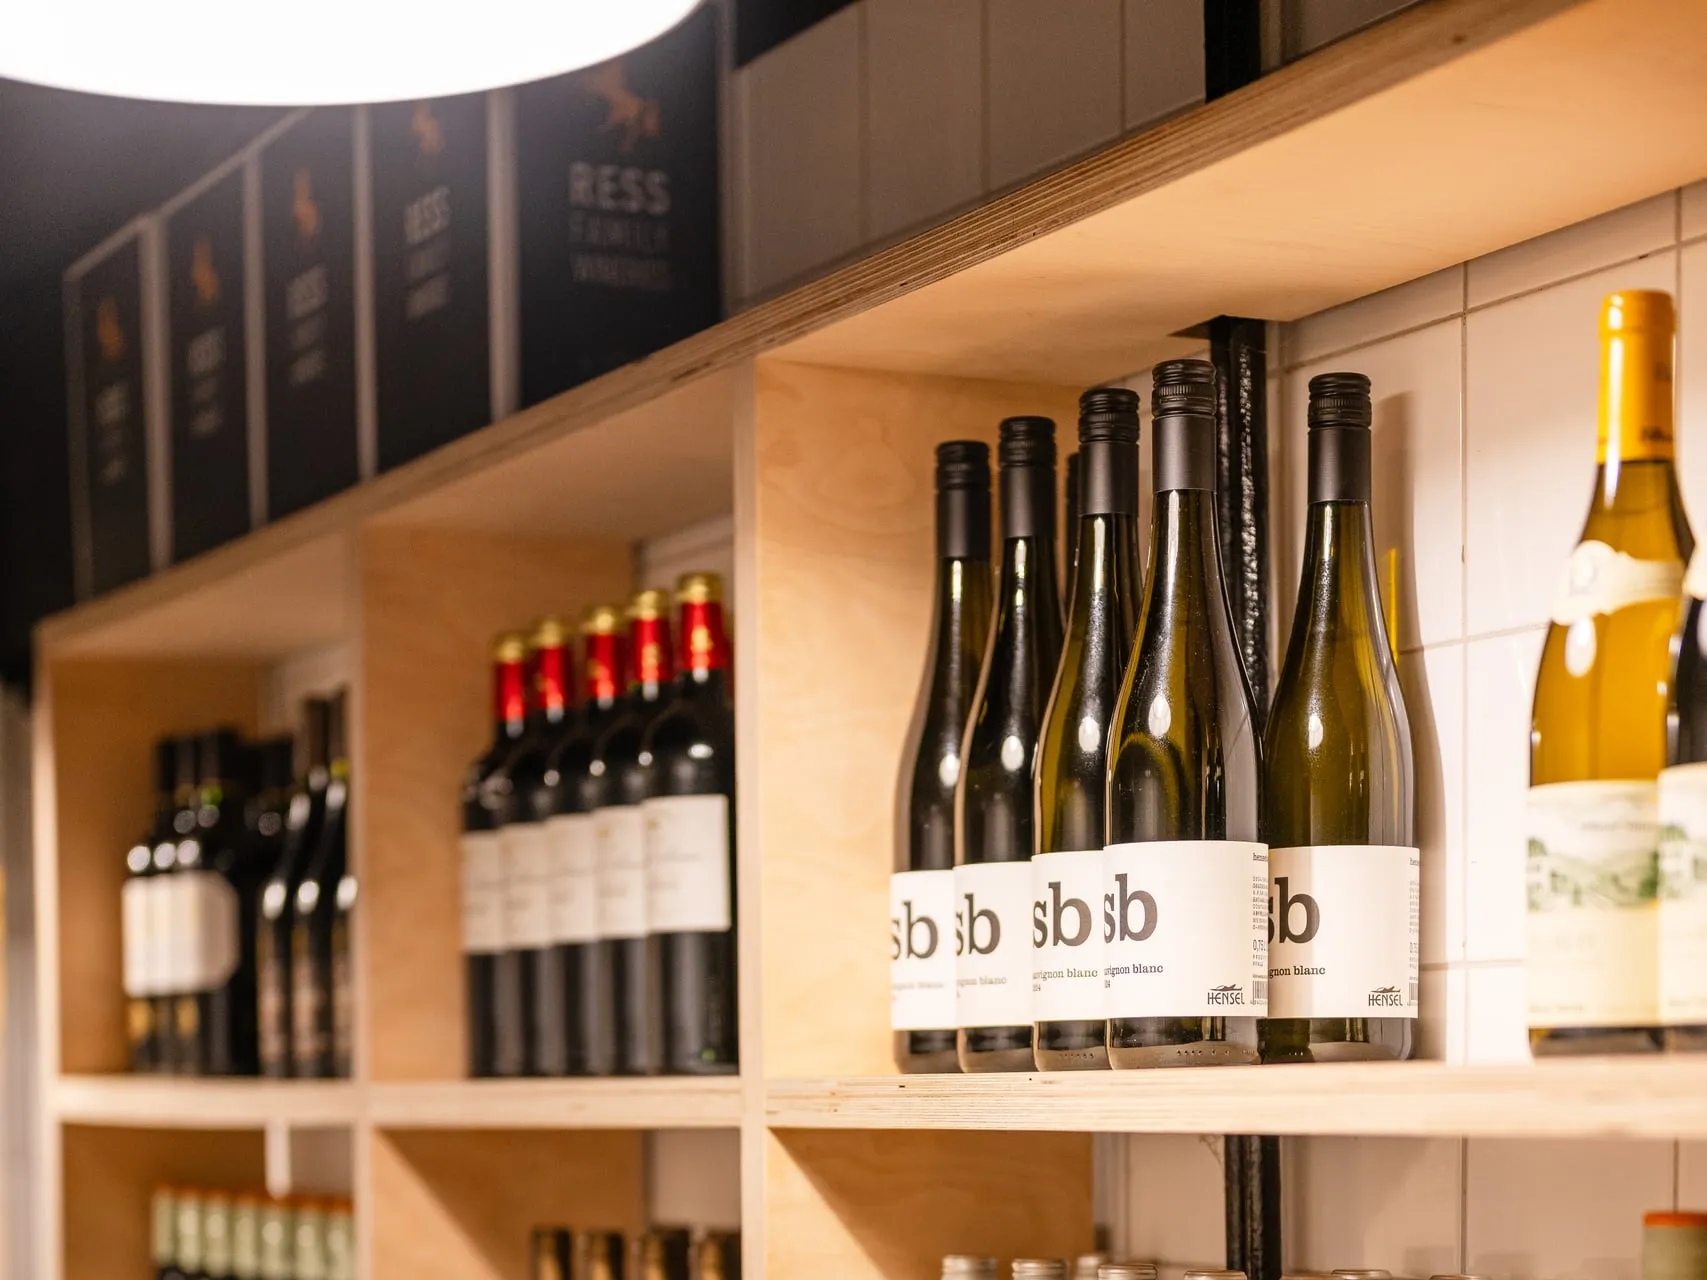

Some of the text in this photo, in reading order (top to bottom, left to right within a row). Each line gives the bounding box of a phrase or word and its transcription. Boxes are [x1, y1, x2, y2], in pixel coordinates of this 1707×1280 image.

[569, 162, 670, 216] RESS
[1104, 873, 1158, 944] sb
[1033, 881, 1092, 949] sb
[1067, 967, 1098, 979] blanc
[1132, 963, 1164, 974] blanc
[1293, 965, 1326, 976] blanc
[1207, 992, 1245, 1005] HENSEL
[1368, 994, 1403, 1006] HENSEL
